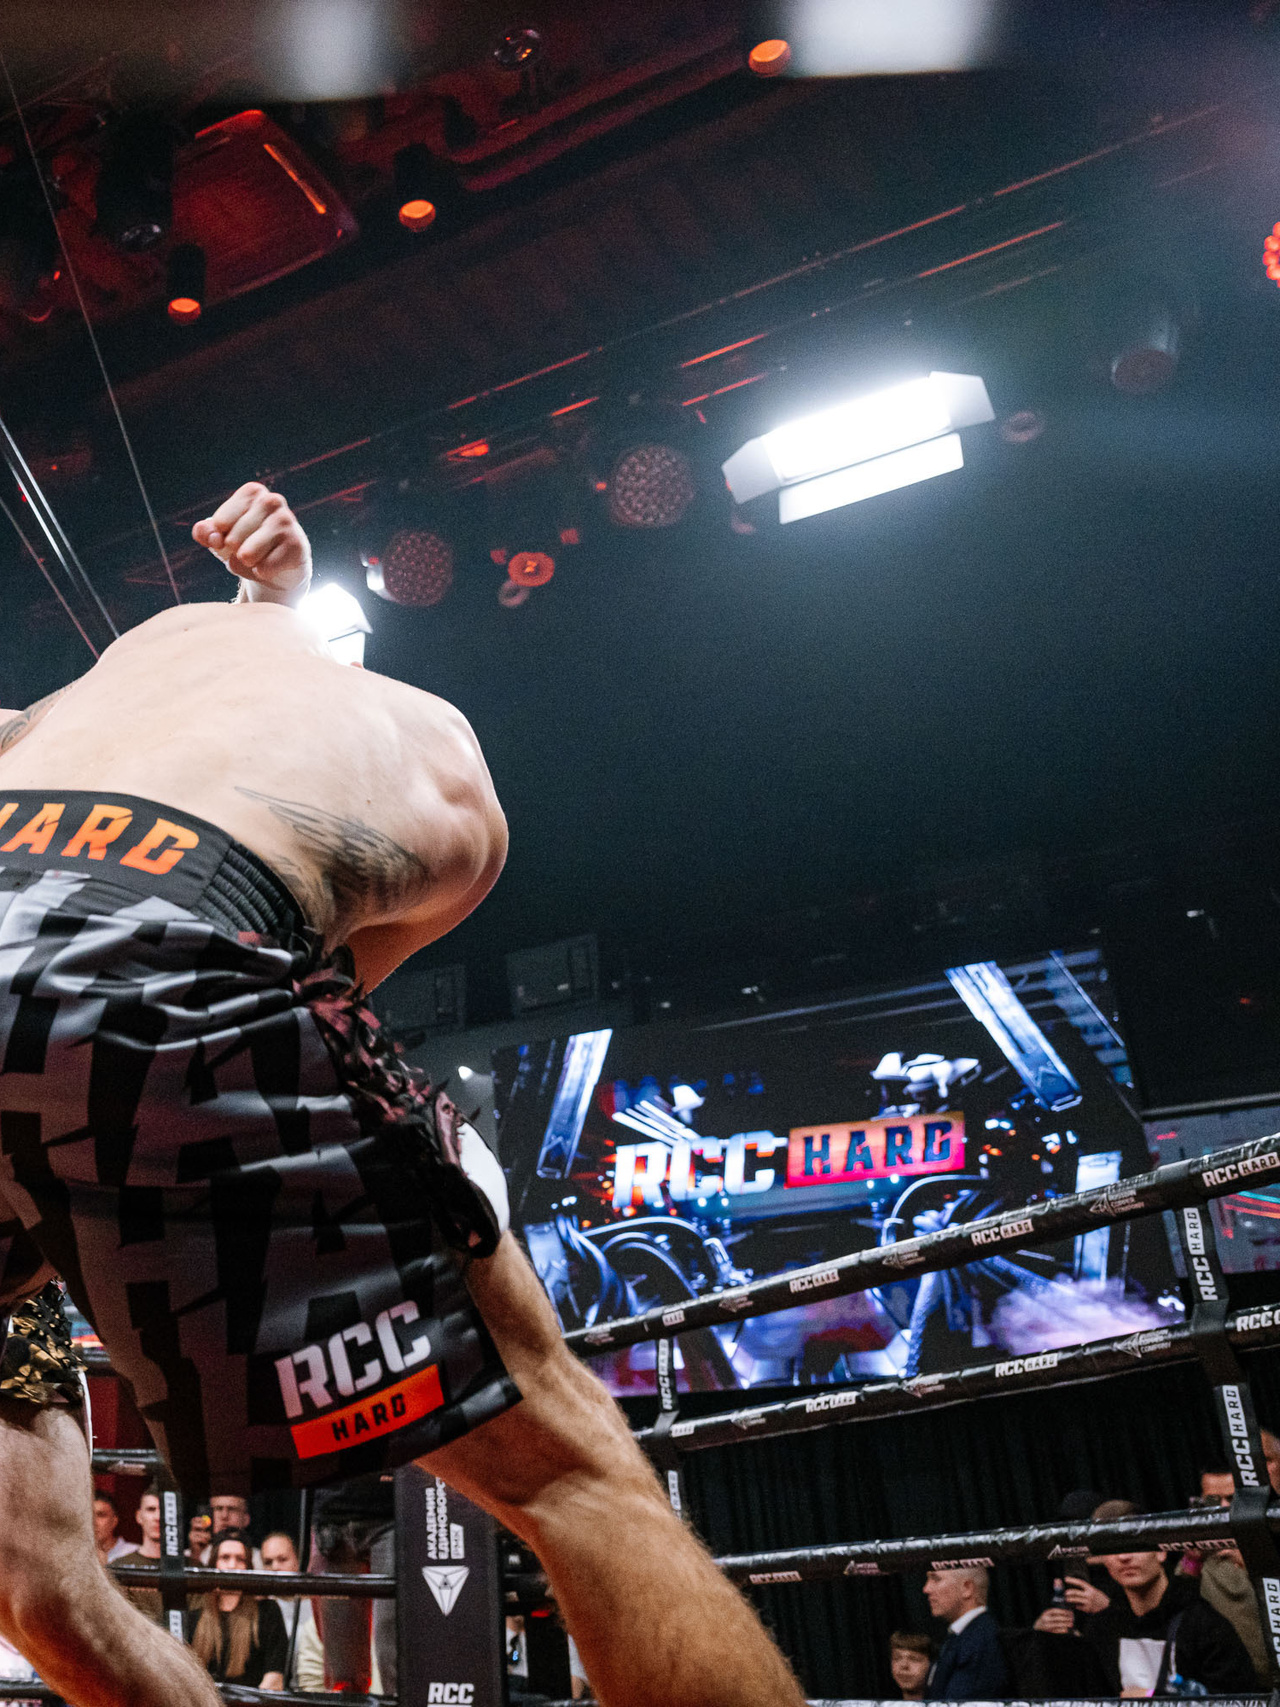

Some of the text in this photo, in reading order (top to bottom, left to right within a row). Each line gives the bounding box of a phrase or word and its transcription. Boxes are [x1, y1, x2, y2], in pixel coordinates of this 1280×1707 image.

[612, 1120, 953, 1209] RCC HARD
[1202, 1154, 1278, 1188] RCC HARD
[971, 1226, 1001, 1247] RCC
[1186, 1211, 1219, 1301] RCC HARD
[789, 1275, 814, 1293] RCC
[1236, 1311, 1271, 1332] RCC
[274, 1300, 432, 1420] RCC
[994, 1360, 1024, 1378] RCC
[658, 1376, 673, 1411] RCC
[805, 1397, 832, 1414] RCC
[331, 1393, 407, 1441] HARD
[1225, 1389, 1259, 1486] RCC HARD
[427, 1682, 474, 1704] RCC
